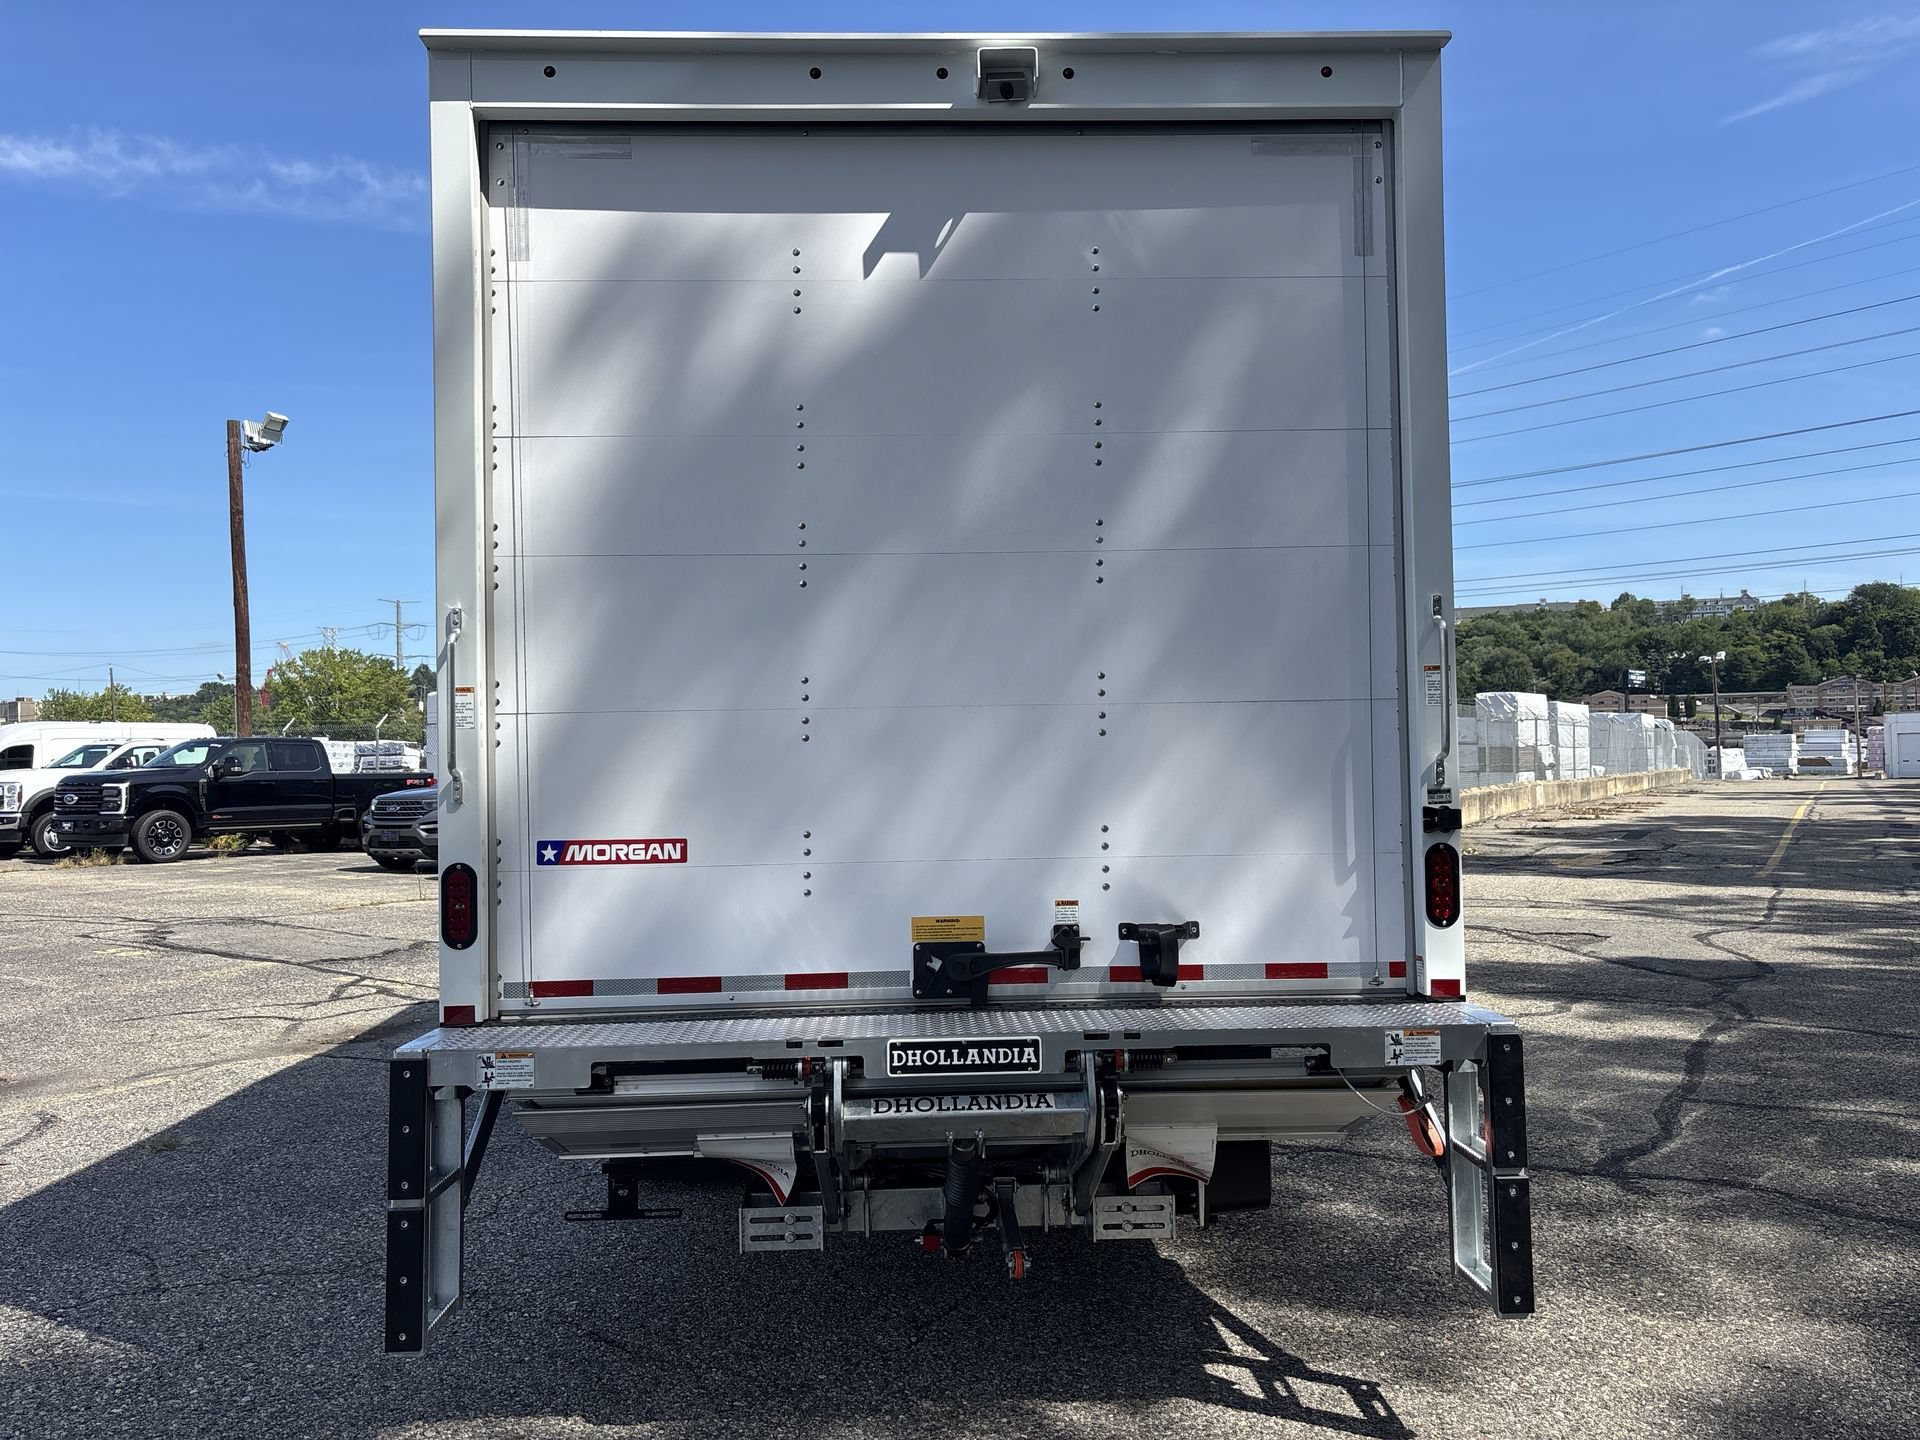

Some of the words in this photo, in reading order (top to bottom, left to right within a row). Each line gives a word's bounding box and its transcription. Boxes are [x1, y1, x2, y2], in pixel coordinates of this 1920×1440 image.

[565, 843, 682, 862] MORGAN
[892, 1047, 1038, 1067] DHOLLANDIA
[873, 1093, 1054, 1114] DHOLLANDIA
